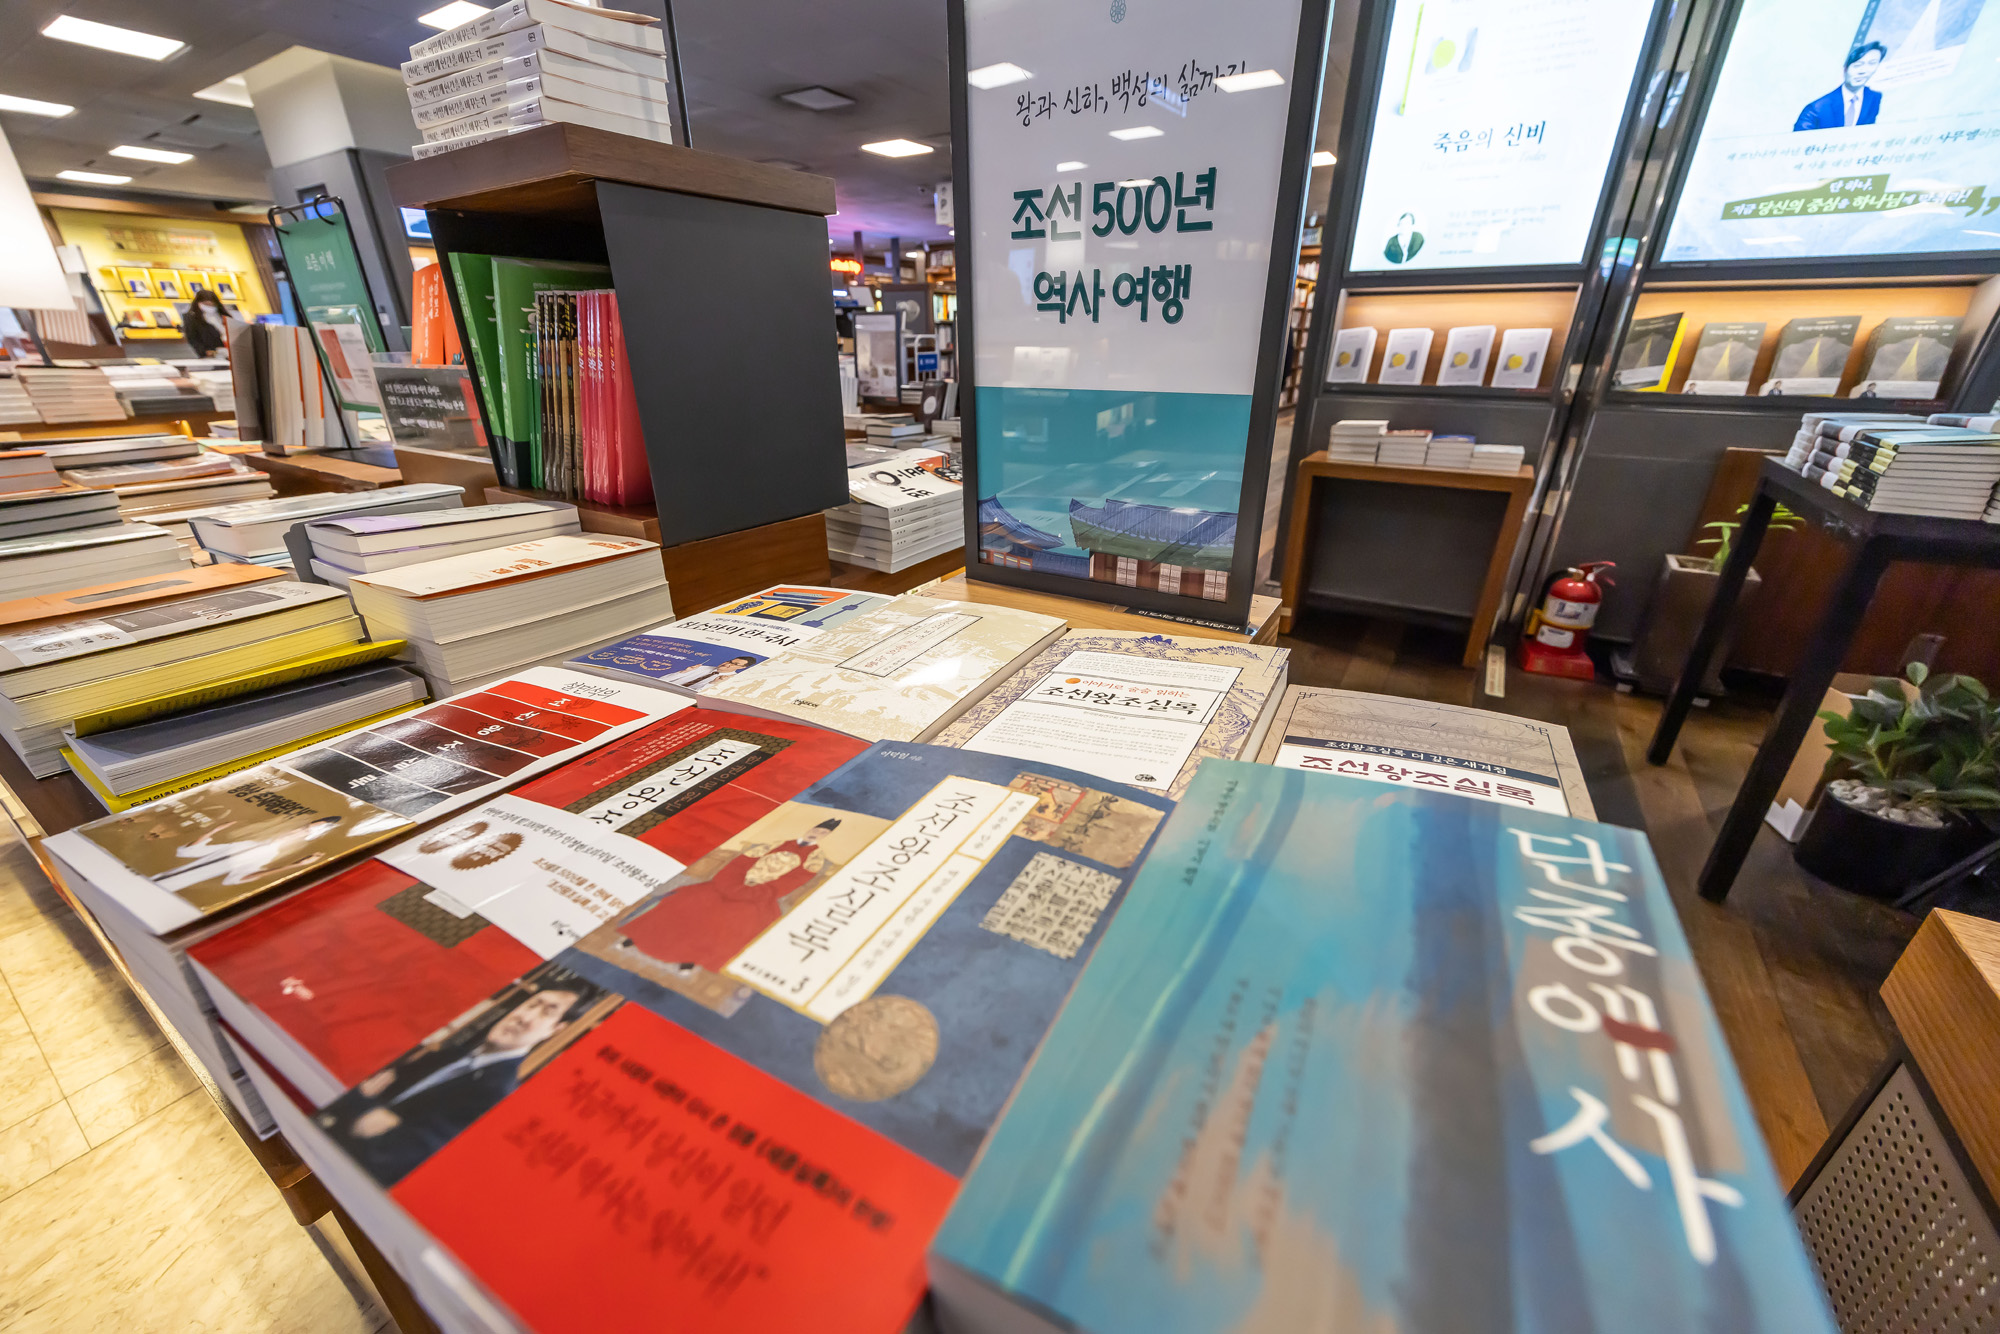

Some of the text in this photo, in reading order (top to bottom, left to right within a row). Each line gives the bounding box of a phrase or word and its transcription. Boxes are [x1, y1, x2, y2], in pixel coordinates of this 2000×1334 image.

[1016, 90, 1057, 127] 왕과
[1063, 83, 1109, 115] 신하,
[1111, 69, 1168, 114] 백성의
[1433, 120, 1547, 154] 죽음의 신비
[1010, 166, 1218, 243] 조선 500년
[1730, 203, 1757, 216] 지금
[1758, 198, 1806, 217] 당신의
[1806, 195, 1850, 214] 중심을
[1033, 263, 1192, 325] 역사 여행
[745, 626, 801, 648] 한국사
[561, 681, 621, 700] 설민석의
[1036, 685, 1202, 716] 조선왕조실록
[1082, 678, 1125, 692] 이야기로
[1127, 683, 1154, 696] 술술
[880, 749, 910, 762] 이덕일
[1325, 740, 1407, 758] 조선왕조실록
[1411, 751, 1425, 761] 더
[1429, 754, 1458, 766] 깊은
[1299, 754, 1536, 807] 조선왕조실록
[788, 791, 978, 963] 조선왕조실록
